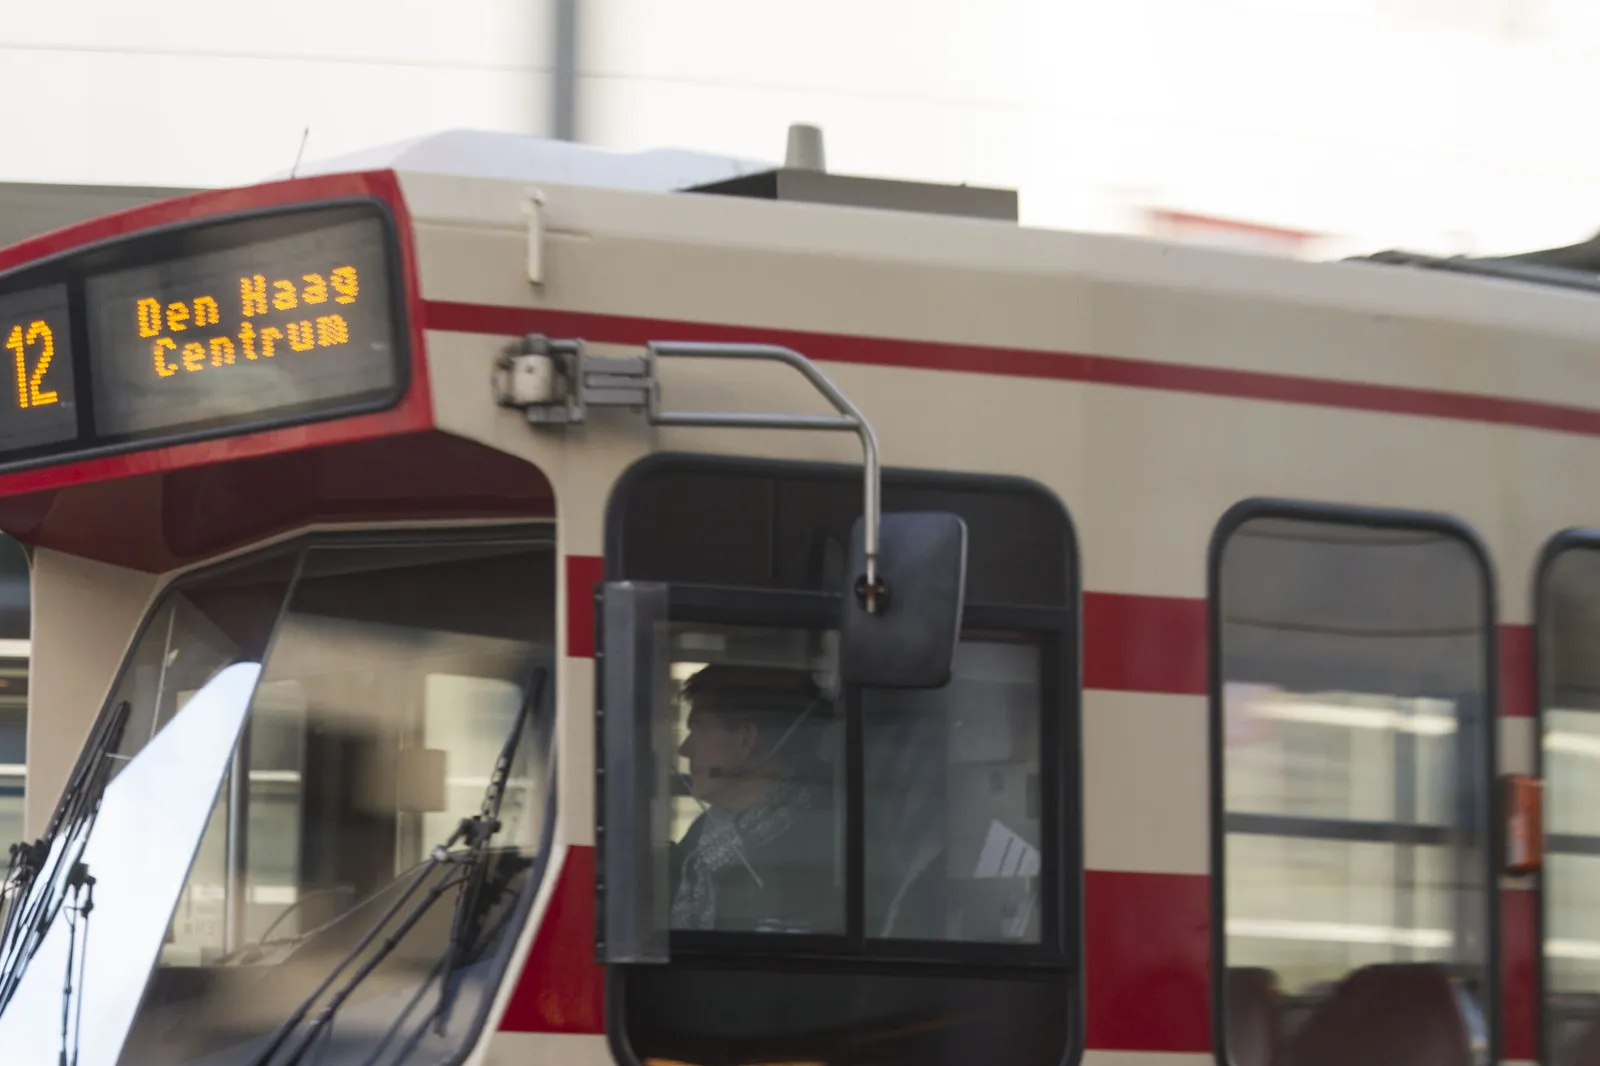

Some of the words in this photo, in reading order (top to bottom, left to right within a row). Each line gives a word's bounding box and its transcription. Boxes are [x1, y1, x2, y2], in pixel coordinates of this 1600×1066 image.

[137, 296, 219, 338] Den
[240, 265, 359, 317] Haag
[5, 320, 58, 408] 12
[152, 314, 349, 378] Centrum
